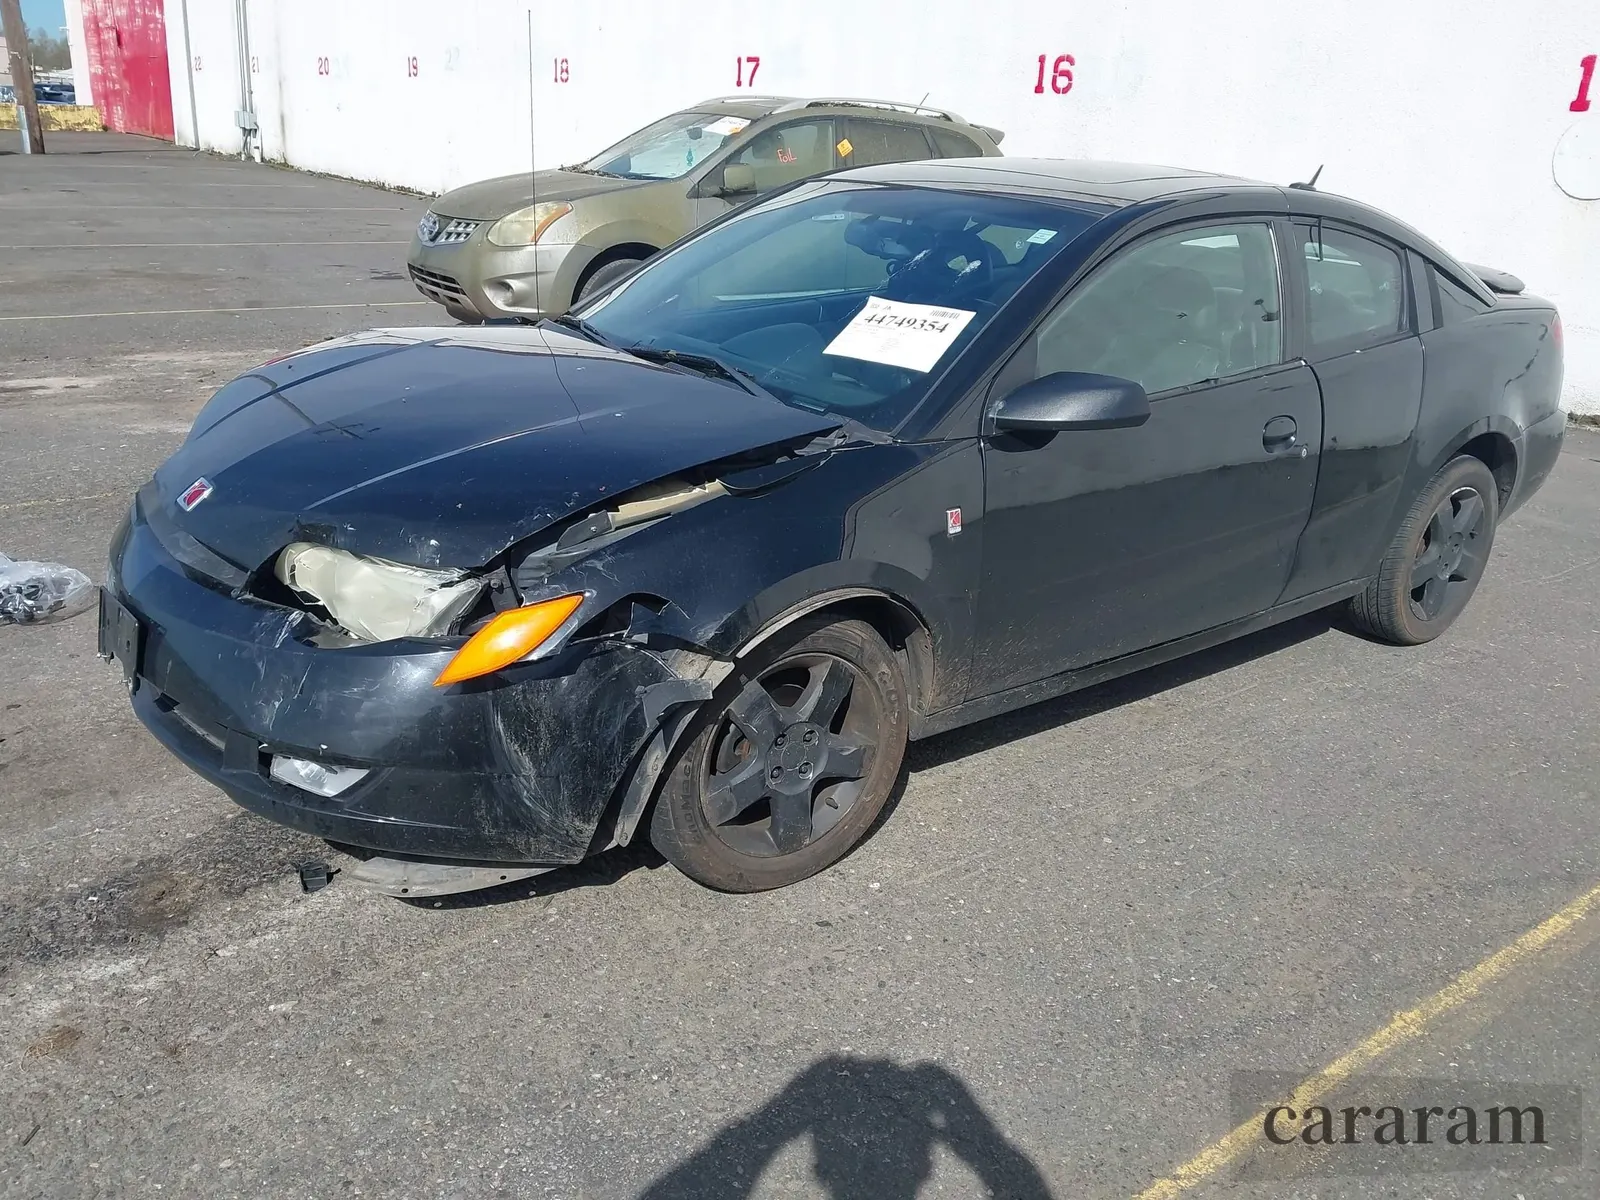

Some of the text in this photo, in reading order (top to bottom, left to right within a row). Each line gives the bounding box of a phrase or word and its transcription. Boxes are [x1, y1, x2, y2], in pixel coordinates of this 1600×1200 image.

[252, 56, 260, 73] 21
[317, 56, 330, 76] 20
[407, 57, 419, 77] 19
[554, 58, 570, 84] 18
[735, 56, 760, 88] 17
[1033, 54, 1076, 95] 16
[1569, 54, 1598, 112] 1
[864, 313, 950, 334] 44749354
